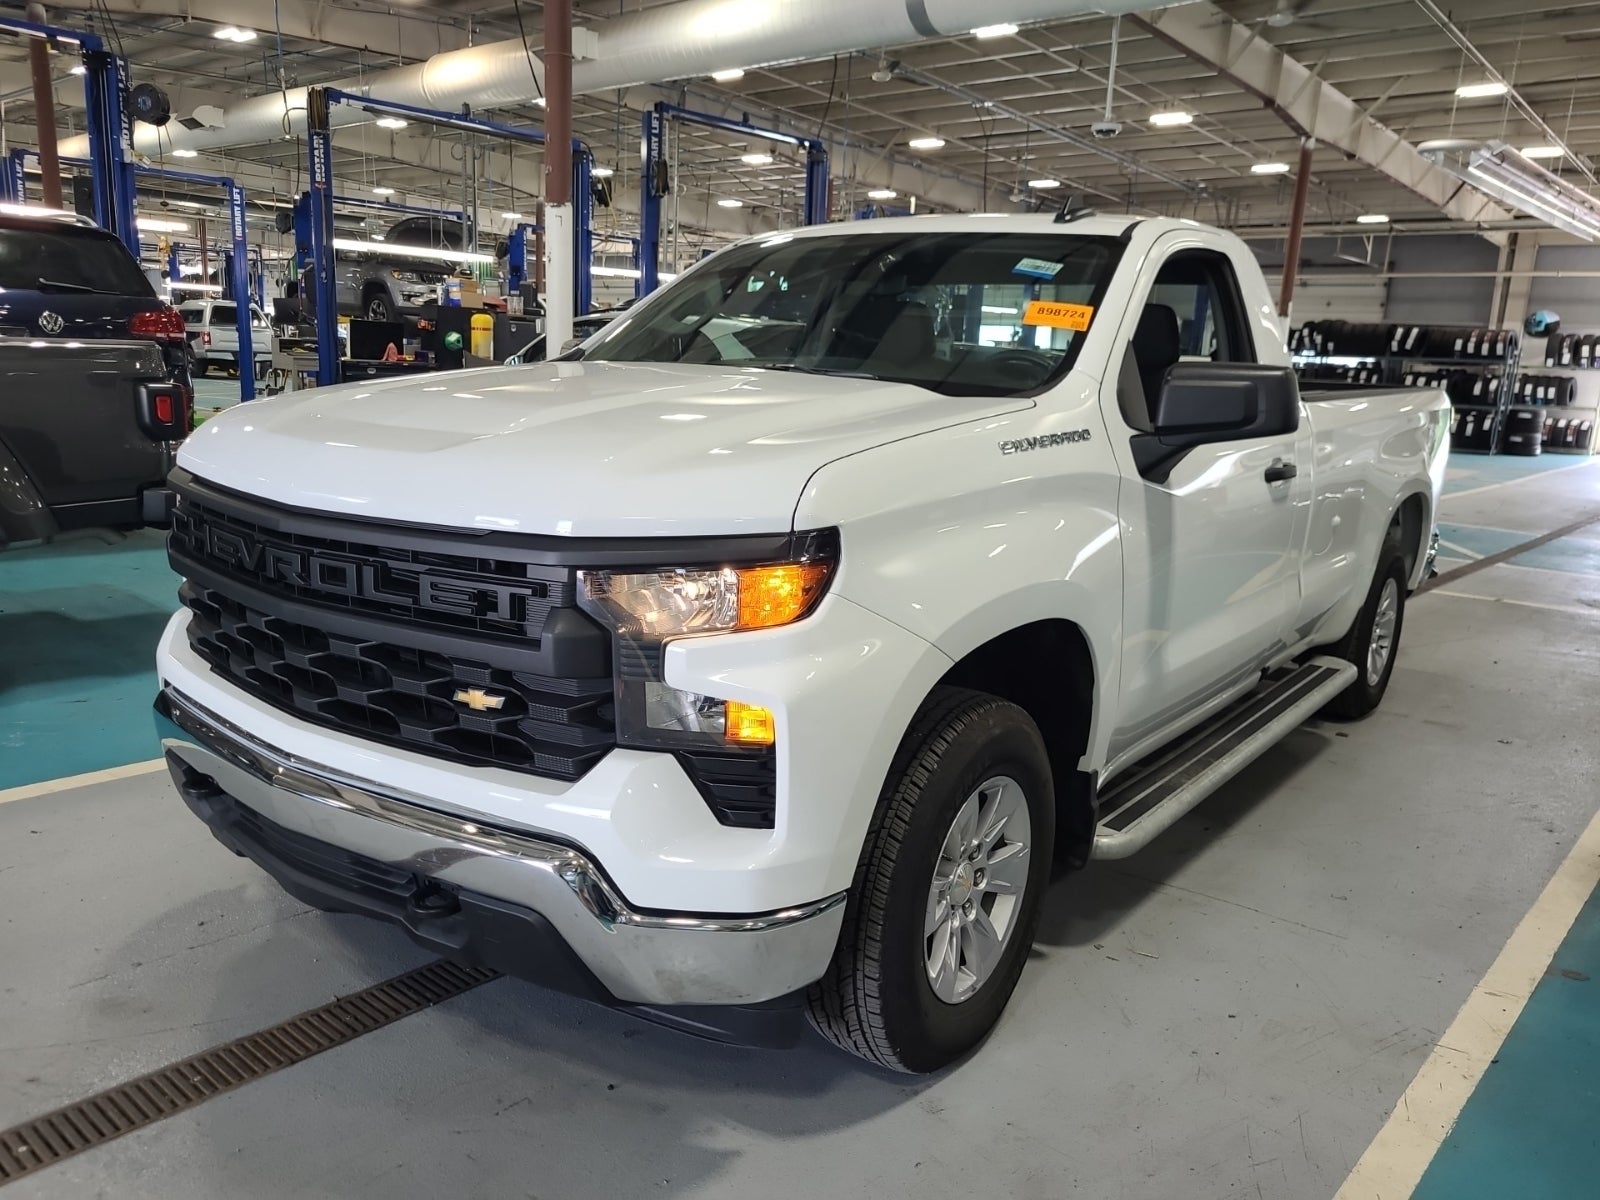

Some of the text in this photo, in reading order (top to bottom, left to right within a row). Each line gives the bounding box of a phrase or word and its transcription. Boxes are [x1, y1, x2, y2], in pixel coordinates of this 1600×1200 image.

[651, 112, 660, 134] LIFT
[233, 187, 243, 237] ROTARY LIFT
[1037, 307, 1086, 319] 898724
[998, 429, 1091, 455] SILVERADO
[171, 508, 548, 624] CHEVROLET
